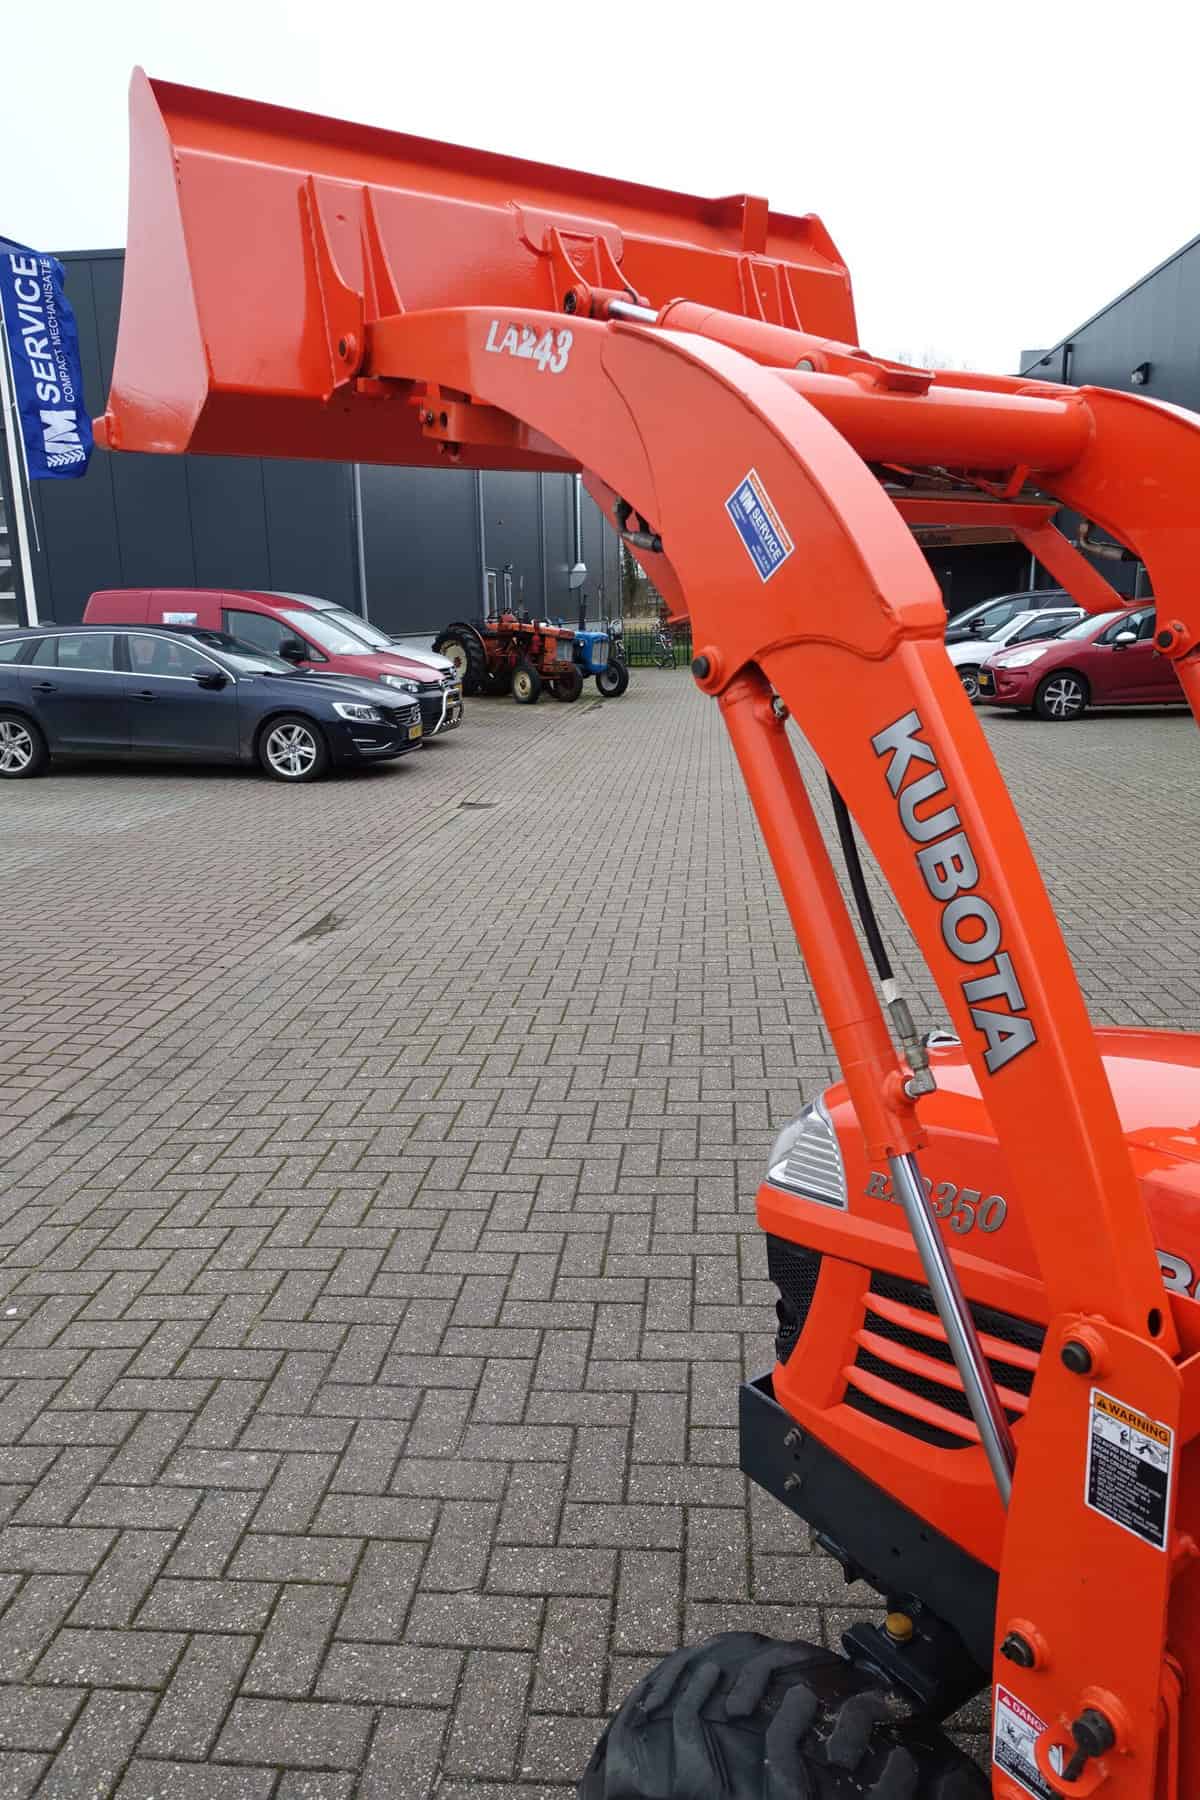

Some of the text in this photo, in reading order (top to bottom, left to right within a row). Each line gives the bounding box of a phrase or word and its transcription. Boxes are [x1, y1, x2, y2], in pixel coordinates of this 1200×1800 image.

[10, 254, 61, 404] SERVICE
[40, 258, 75, 403] COMPACT MECHANISATIE
[485, 320, 573, 373] LA243
[752, 507, 782, 561] SERVICE
[871, 709, 1037, 1076] KUBOTA
[1109, 1404, 1168, 1442] WARNING
